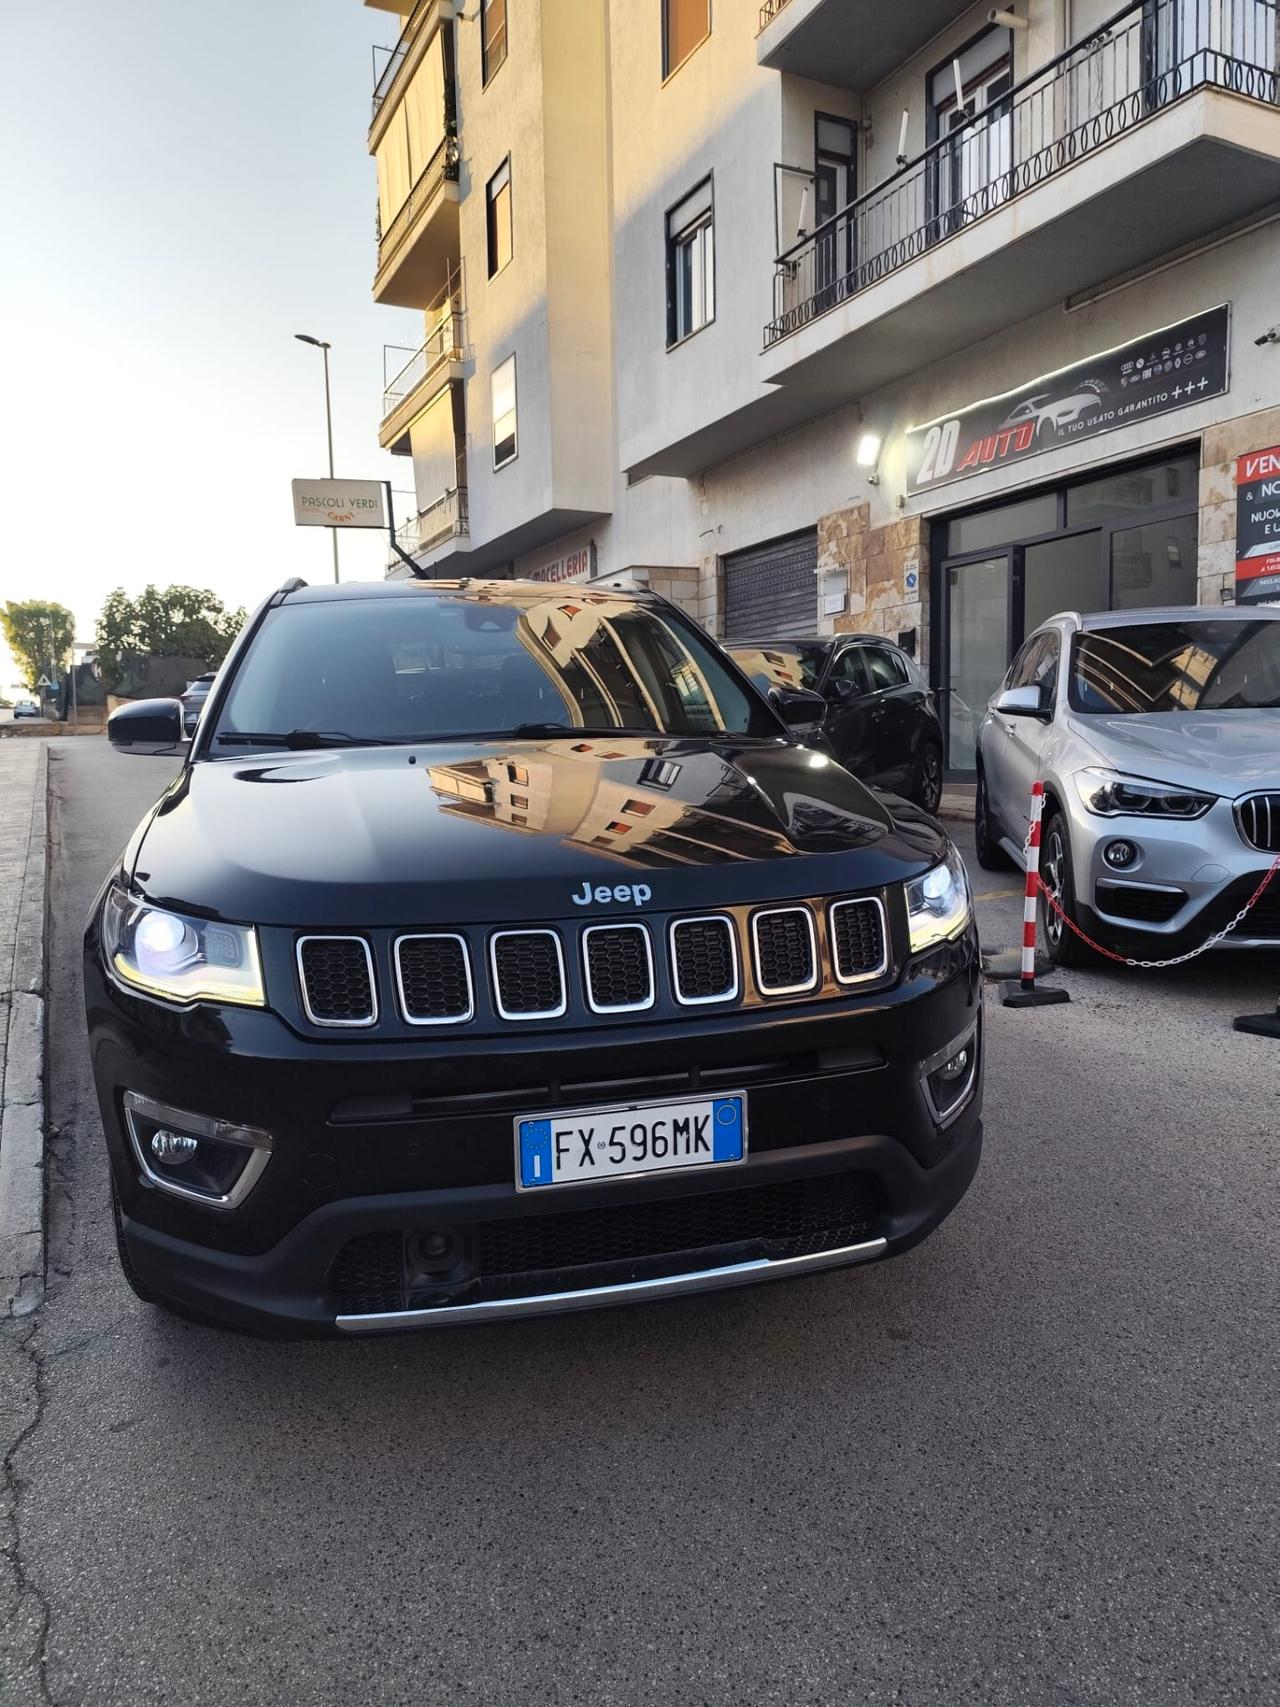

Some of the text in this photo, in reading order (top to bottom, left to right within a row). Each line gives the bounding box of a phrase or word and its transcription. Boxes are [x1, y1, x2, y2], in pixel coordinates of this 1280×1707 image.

[1058, 429, 1065, 437] IL
[1068, 421, 1084, 433] TUO
[1087, 411, 1115, 426] USATO
[1118, 392, 1168, 416] GARANTITO
[956, 420, 1036, 472] AUTO
[301, 496, 378, 509] PASCOLI VERDI
[533, 550, 588, 583] MACELLERIA
[571, 882, 652, 906] Jeep
